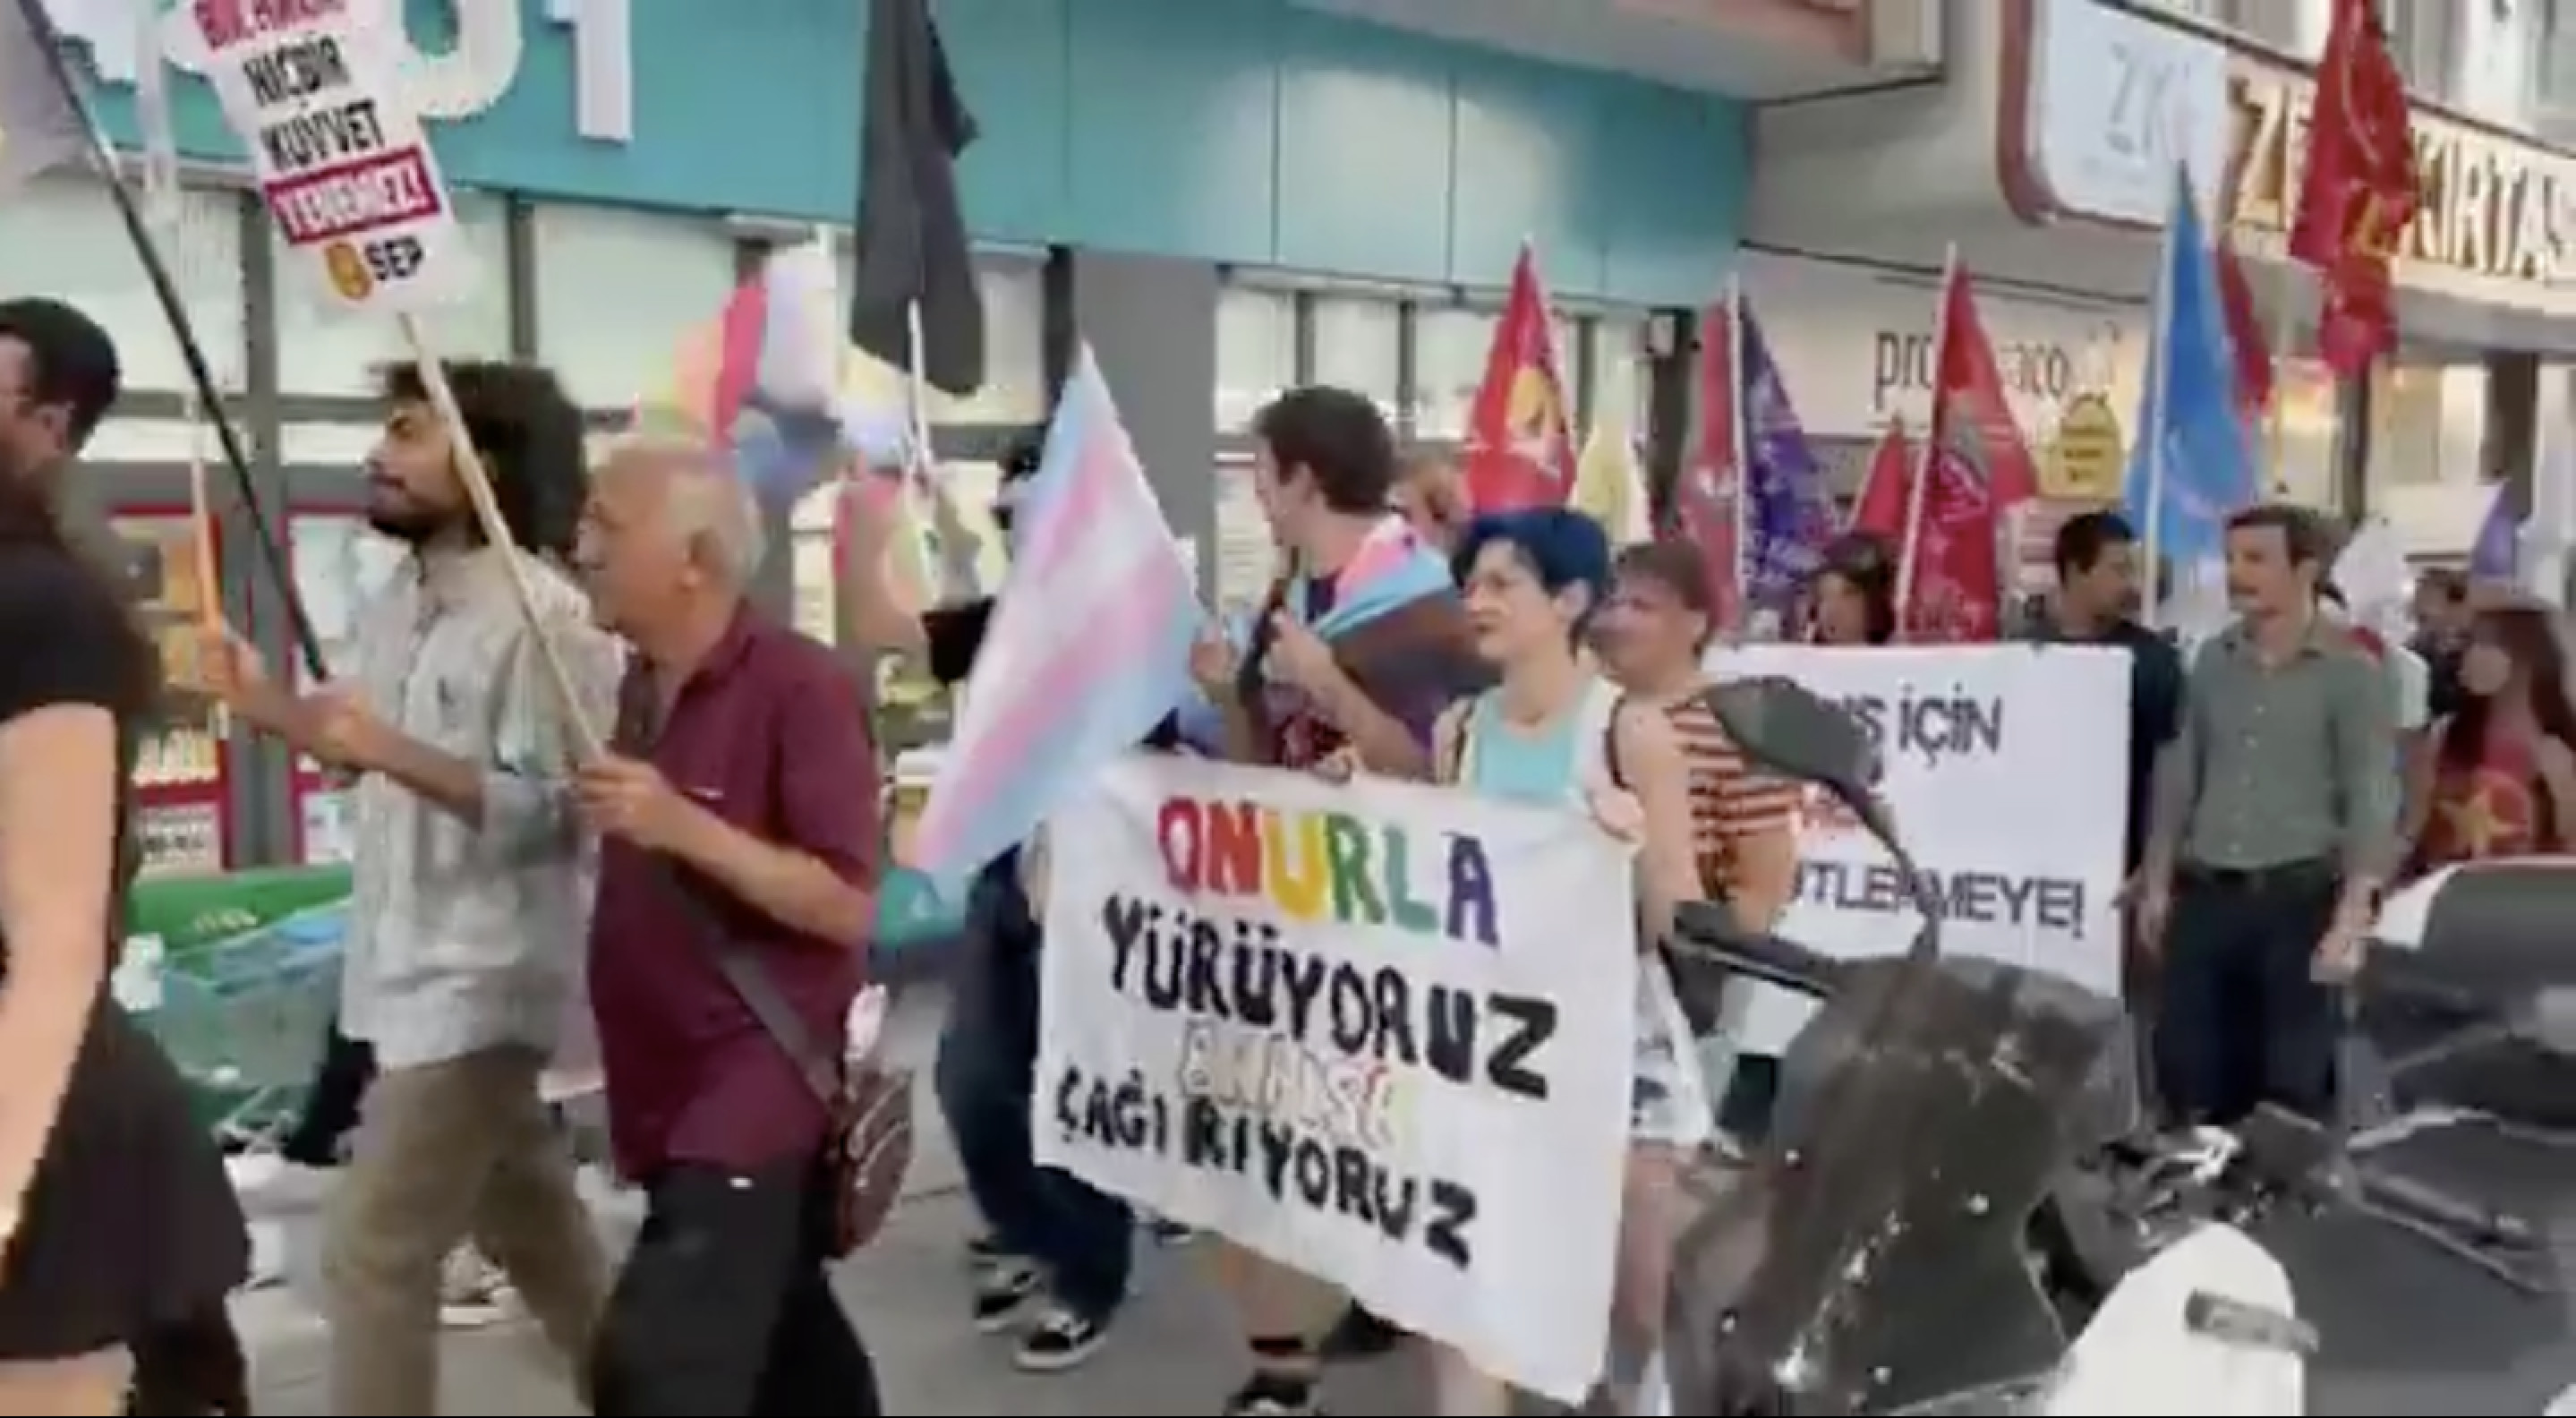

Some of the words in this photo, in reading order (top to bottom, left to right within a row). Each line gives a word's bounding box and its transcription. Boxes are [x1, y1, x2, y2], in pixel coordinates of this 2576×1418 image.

[260, 97, 385, 170] KUVVET
[363, 235, 423, 281] SEP
[1898, 679, 2003, 772] İÇİN
[1157, 797, 1500, 947] ONURLA
[1102, 893, 1558, 1100] YÜRÜYORUZ
